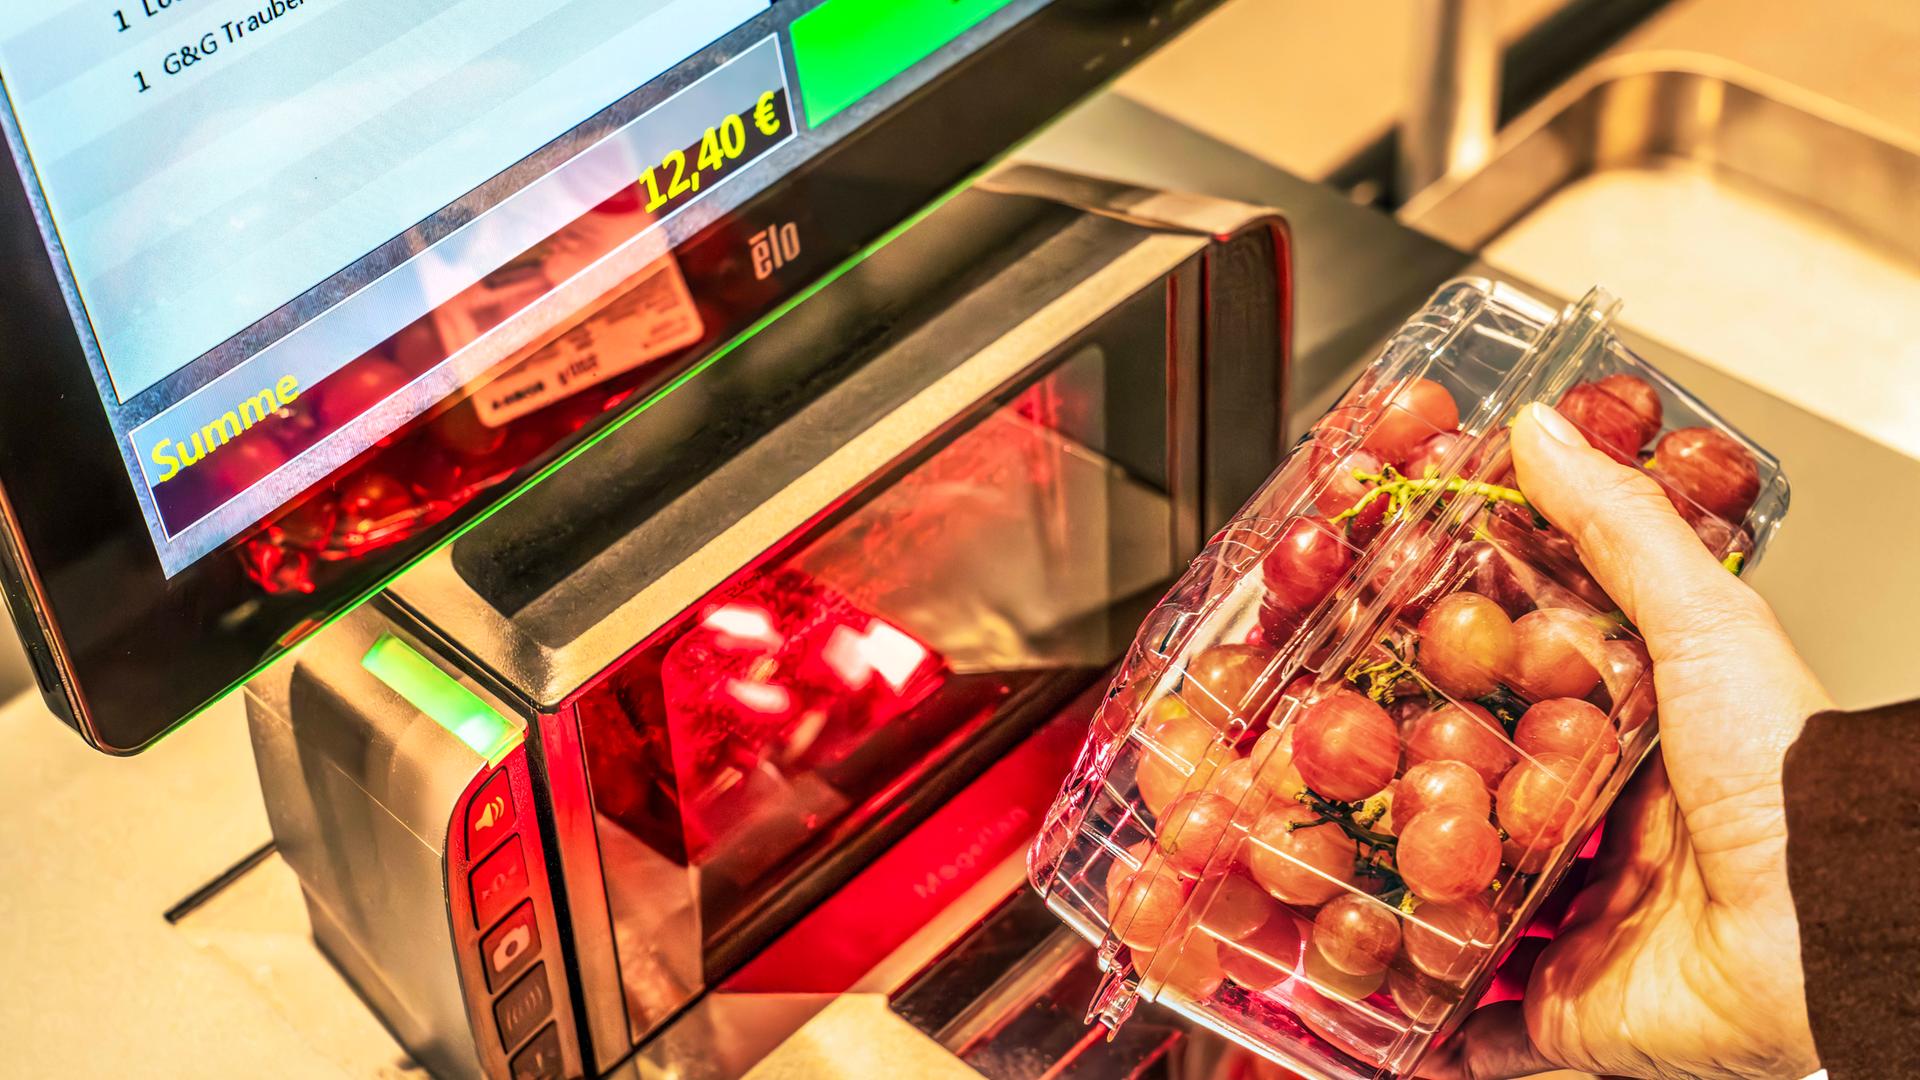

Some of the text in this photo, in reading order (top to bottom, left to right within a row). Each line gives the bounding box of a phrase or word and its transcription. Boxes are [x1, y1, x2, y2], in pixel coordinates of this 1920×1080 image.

[113, 10, 131, 33] 1
[133, 0, 304, 93] 1 G&G Traube
[151, 90, 781, 483] Summe 12,40 €
